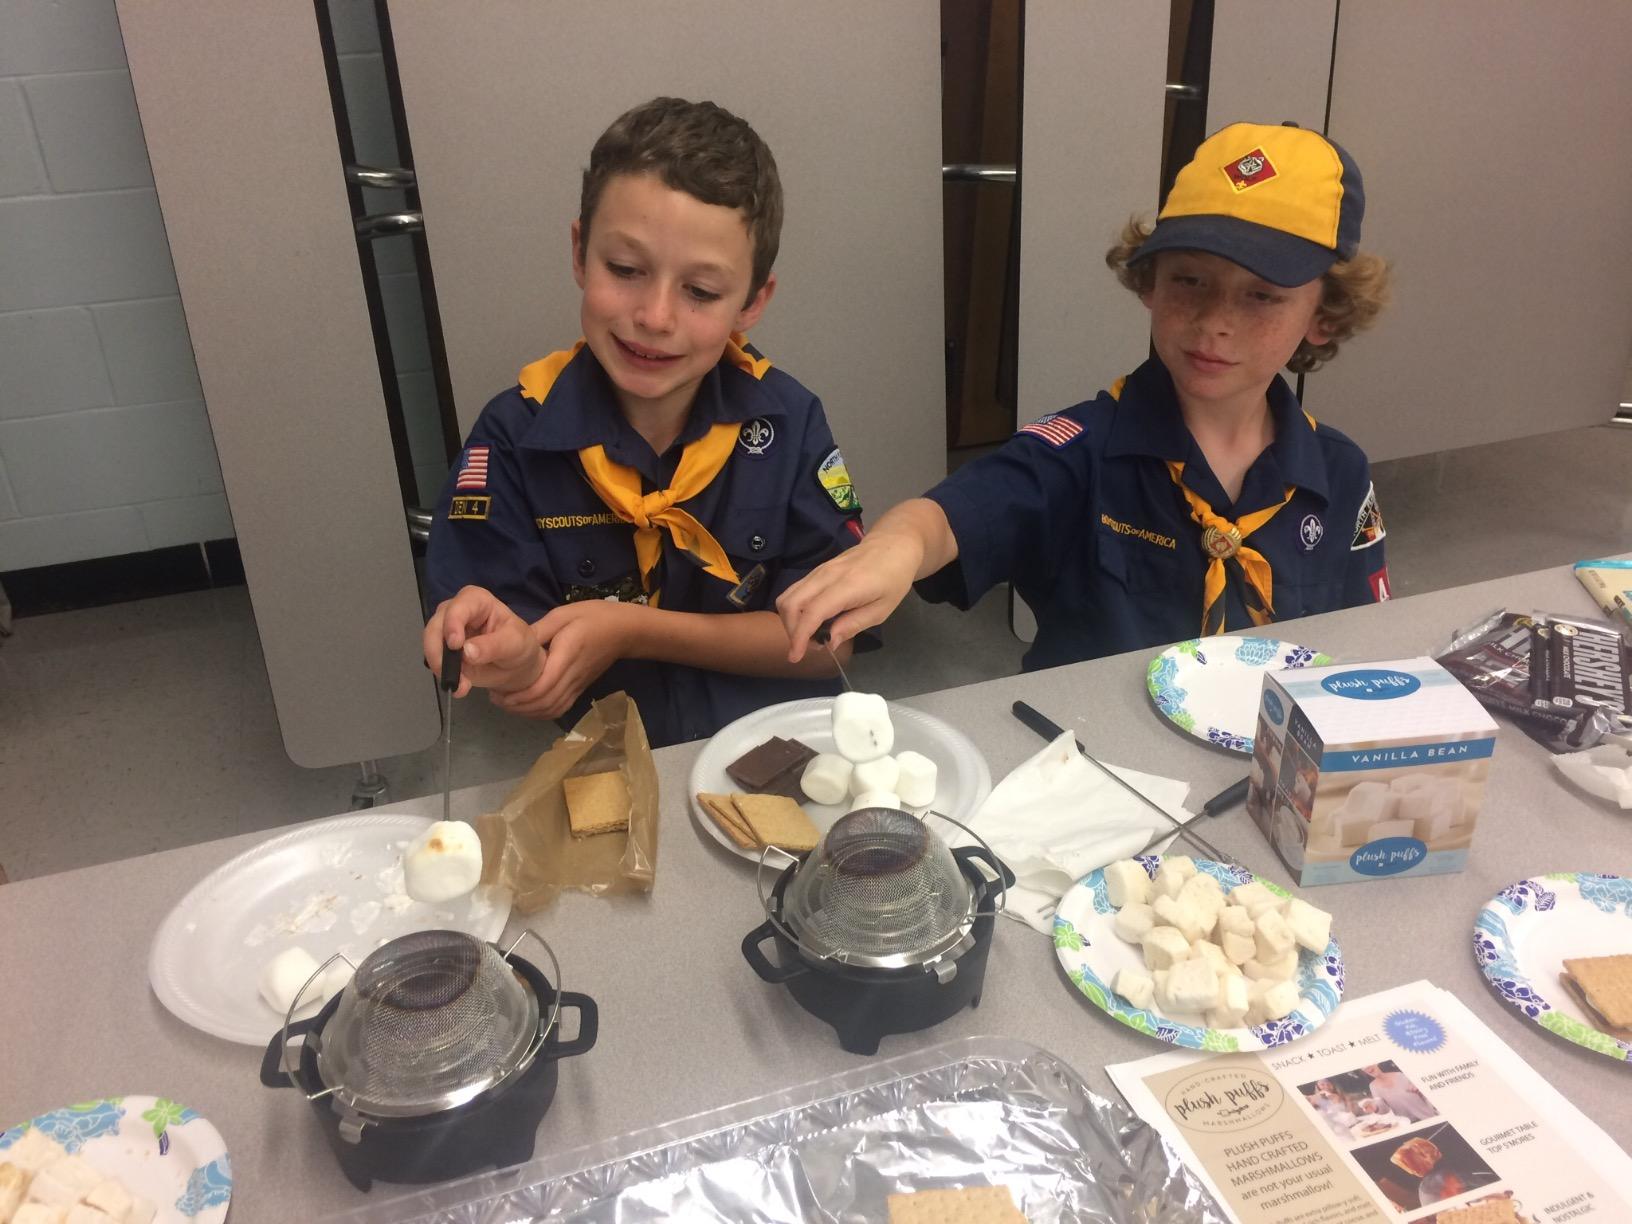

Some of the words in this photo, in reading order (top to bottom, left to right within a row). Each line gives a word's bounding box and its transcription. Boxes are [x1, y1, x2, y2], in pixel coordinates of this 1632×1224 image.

[454, 501, 467, 514] DEN
[472, 500, 478, 514] 4
[1573, 630, 1626, 712] HERSHEY'S
[1328, 678, 1368, 692] plush
[1370, 675, 1410, 689] puffs
[1351, 750, 1419, 763] VANILLA
[1427, 745, 1468, 757] BEAN
[1355, 850, 1387, 866] plush
[1390, 846, 1421, 863] puffs
[1271, 1055, 1307, 1071] SNACK
[1316, 1043, 1349, 1057] TOAST
[1358, 1033, 1382, 1047] MELT
[1204, 1073, 1247, 1083] CRAFTED
[1421, 1073, 1438, 1083] FUN
[1454, 1060, 1479, 1072] FAMILY
[1429, 1081, 1446, 1091] AND
[1445, 1072, 1475, 1086] FRIENDS
[1174, 1091, 1222, 1120] plush
[1223, 1079, 1270, 1106] puffs
[1202, 1102, 1271, 1127] MARSHMALLOWS
[1223, 1140, 1259, 1158] PLUSH
[1260, 1130, 1294, 1147] PUFFS
[1480, 1128, 1516, 1146] GOURMET
[1515, 1121, 1539, 1133] TABLE
[1225, 1155, 1260, 1172] HAND
[1260, 1141, 1309, 1161] CRAFTED
[1486, 1144, 1503, 1154] TOP
[1230, 1151, 1324, 1187] MARSHMALLOWS
[1241, 1188, 1259, 1201] are
[1260, 1181, 1280, 1195] not
[1279, 1174, 1303, 1189] your
[1306, 1163, 1334, 1180] usual
[1260, 1180, 1335, 1210] marshmallow!
[1543, 1194, 1586, 1215] INDULGENT
[1552, 1204, 1596, 1224] NOSTALGIC
